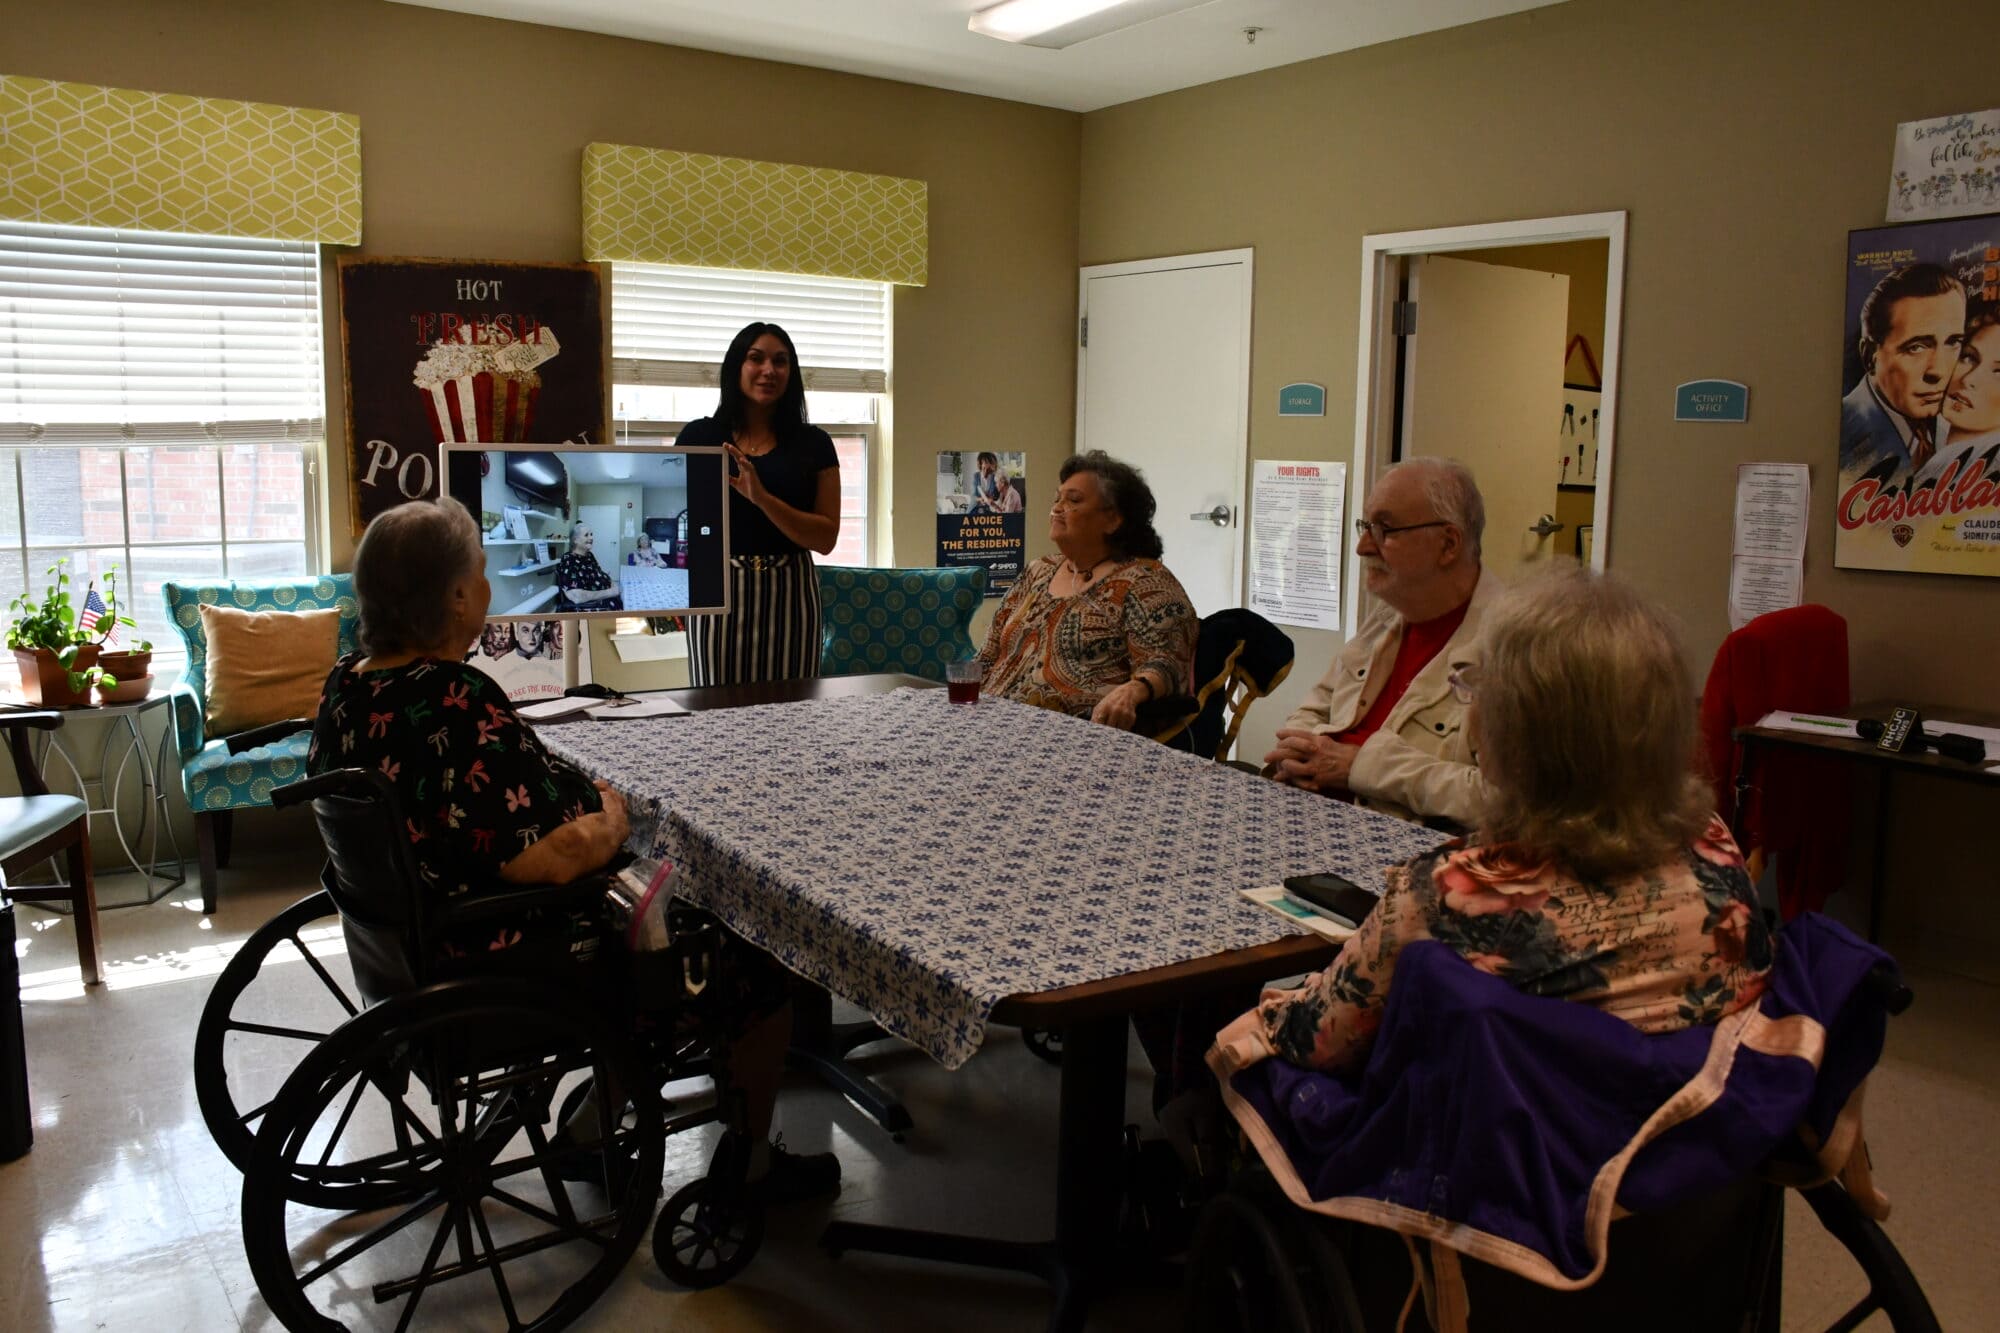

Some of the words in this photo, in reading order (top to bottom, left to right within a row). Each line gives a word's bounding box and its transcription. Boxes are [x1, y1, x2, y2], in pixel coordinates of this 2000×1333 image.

[456, 279, 503, 301] HOT
[410, 311, 545, 345] FRESH
[1690, 393, 1729, 403] ACTIVITY
[1696, 403, 1722, 412] OFFICE
[1277, 466, 1295, 476] YOUR
[1296, 466, 1320, 478] RIGHTS
[963, 516, 970, 525] A
[972, 516, 1003, 525] VOICE
[959, 528, 979, 538] FOR
[942, 541, 964, 550] THE
[966, 538, 1021, 549] RESIDENTS
[1881, 710, 1906, 748] RHCJC
